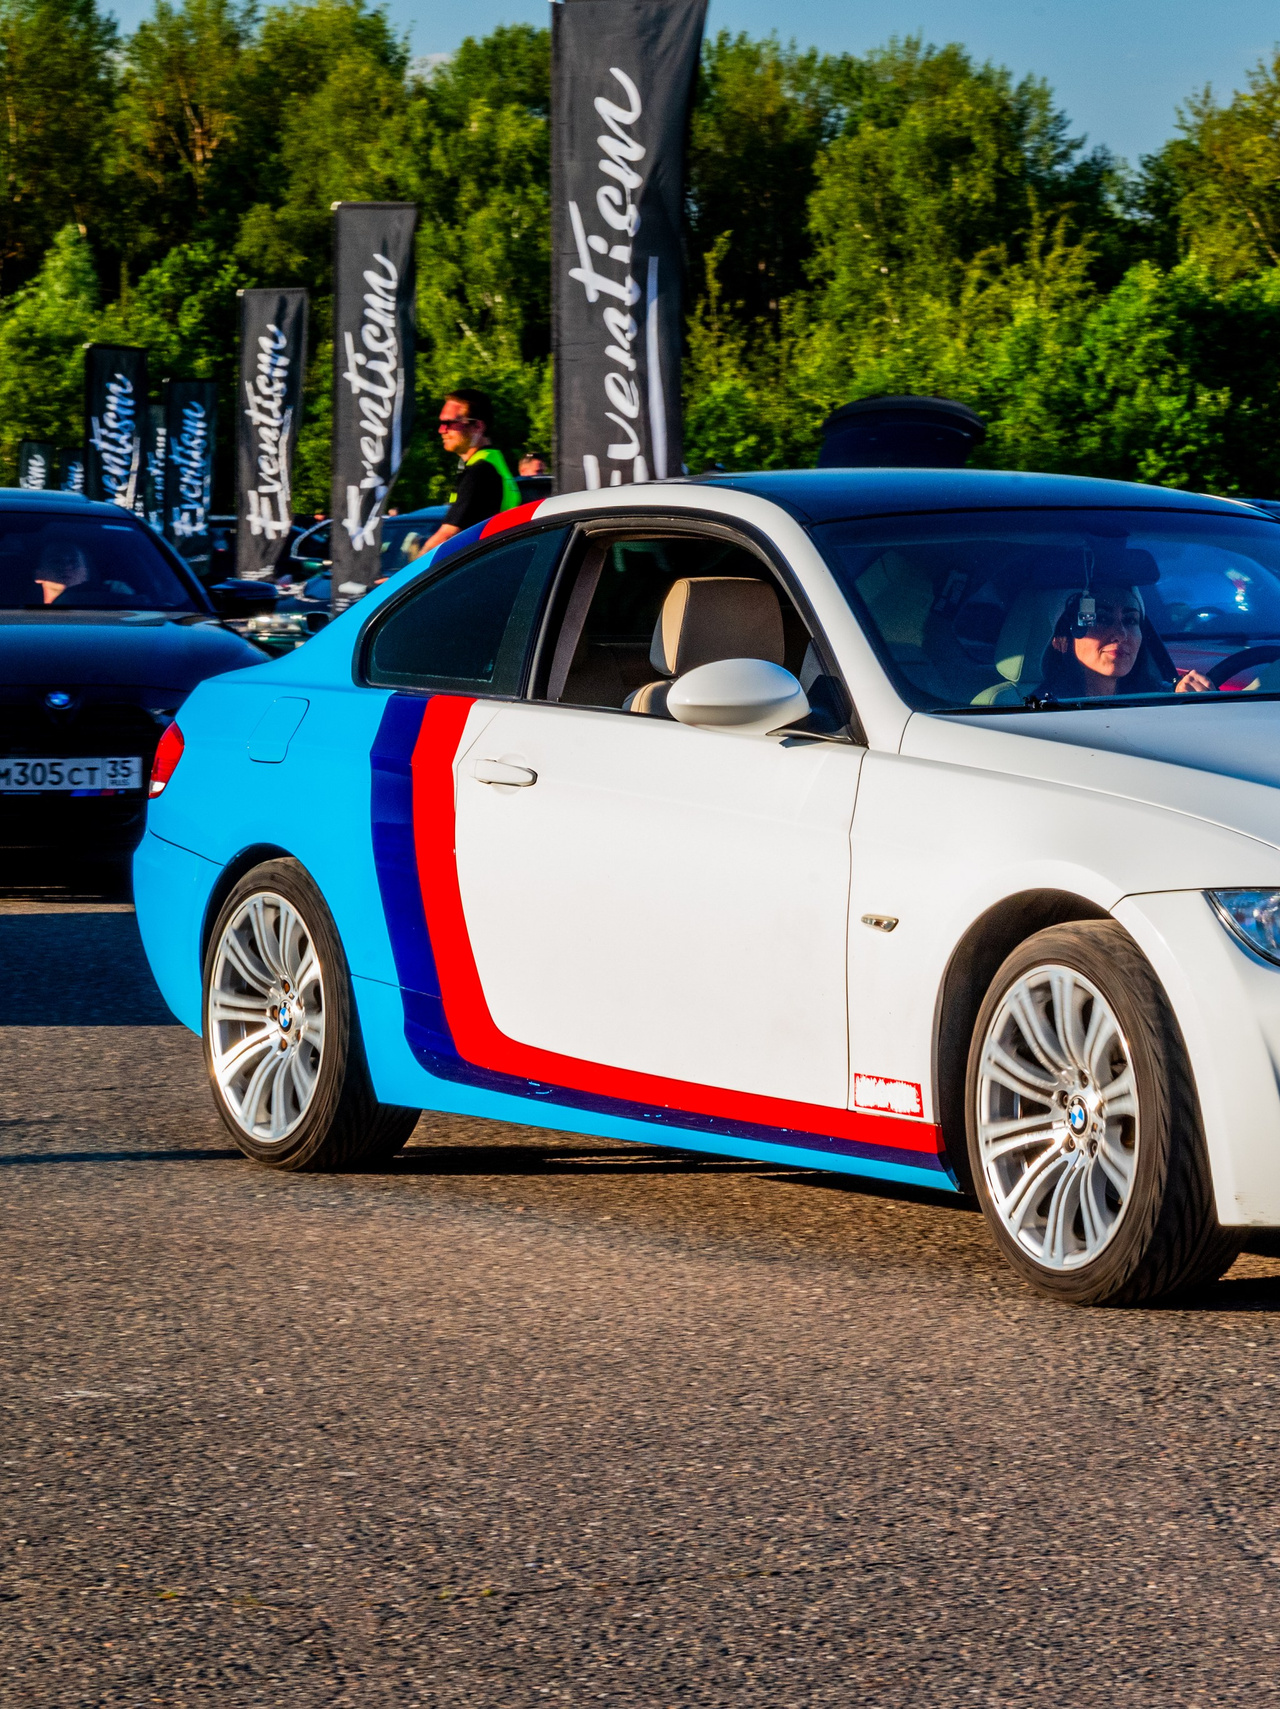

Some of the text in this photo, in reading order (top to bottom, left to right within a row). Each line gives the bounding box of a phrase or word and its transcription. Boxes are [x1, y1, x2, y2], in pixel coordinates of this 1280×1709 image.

[568, 67, 648, 490] ventism
[89, 373, 137, 509] ventism
[169, 401, 209, 536] Eventism
[244, 323, 292, 540] Eventism
[107, 760, 131, 778] 35
